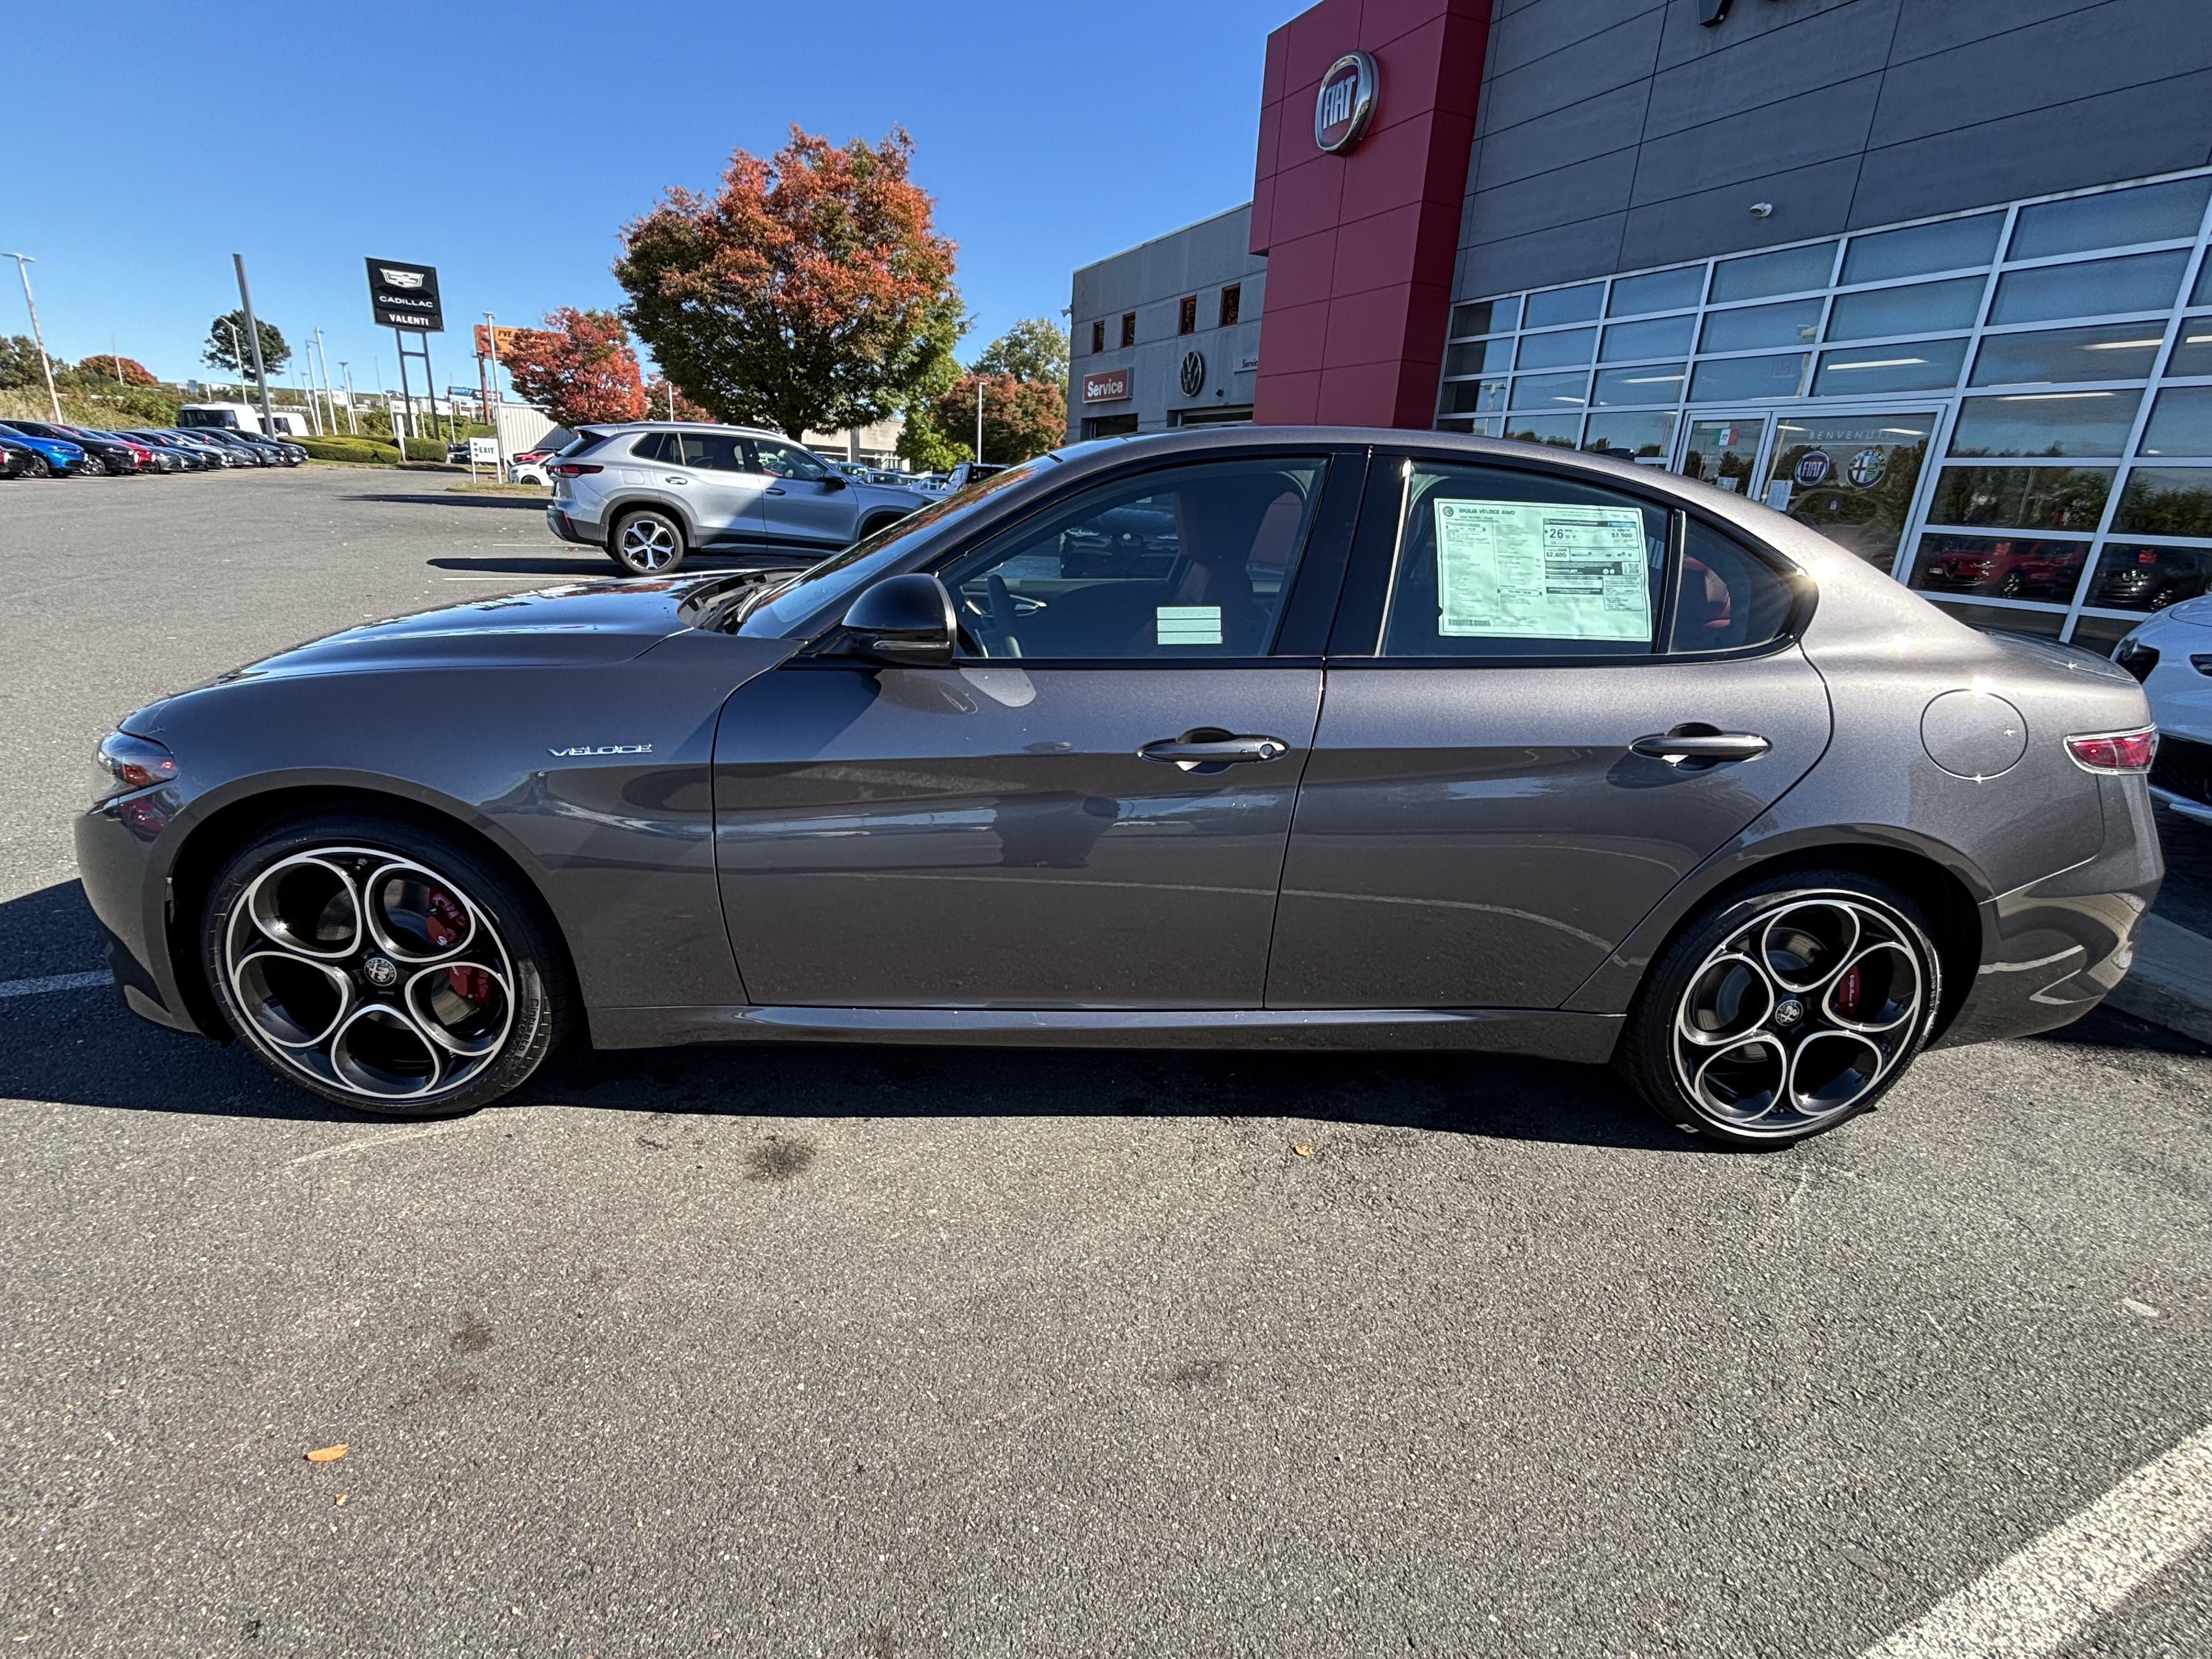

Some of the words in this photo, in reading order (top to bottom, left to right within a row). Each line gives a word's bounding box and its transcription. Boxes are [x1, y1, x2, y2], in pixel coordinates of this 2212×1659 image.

[1323, 75, 1357, 129] FIAT
[379, 296, 433, 308] CADILLAC
[389, 314, 429, 326] VALENTI
[1242, 358, 1257, 369] Servic
[1087, 379, 1123, 397] Service
[1808, 430, 1890, 439] BENVENUTI
[1802, 461, 1823, 477] FIAT
[1549, 528, 1564, 539] 26
[548, 743, 652, 757] VELOCE
